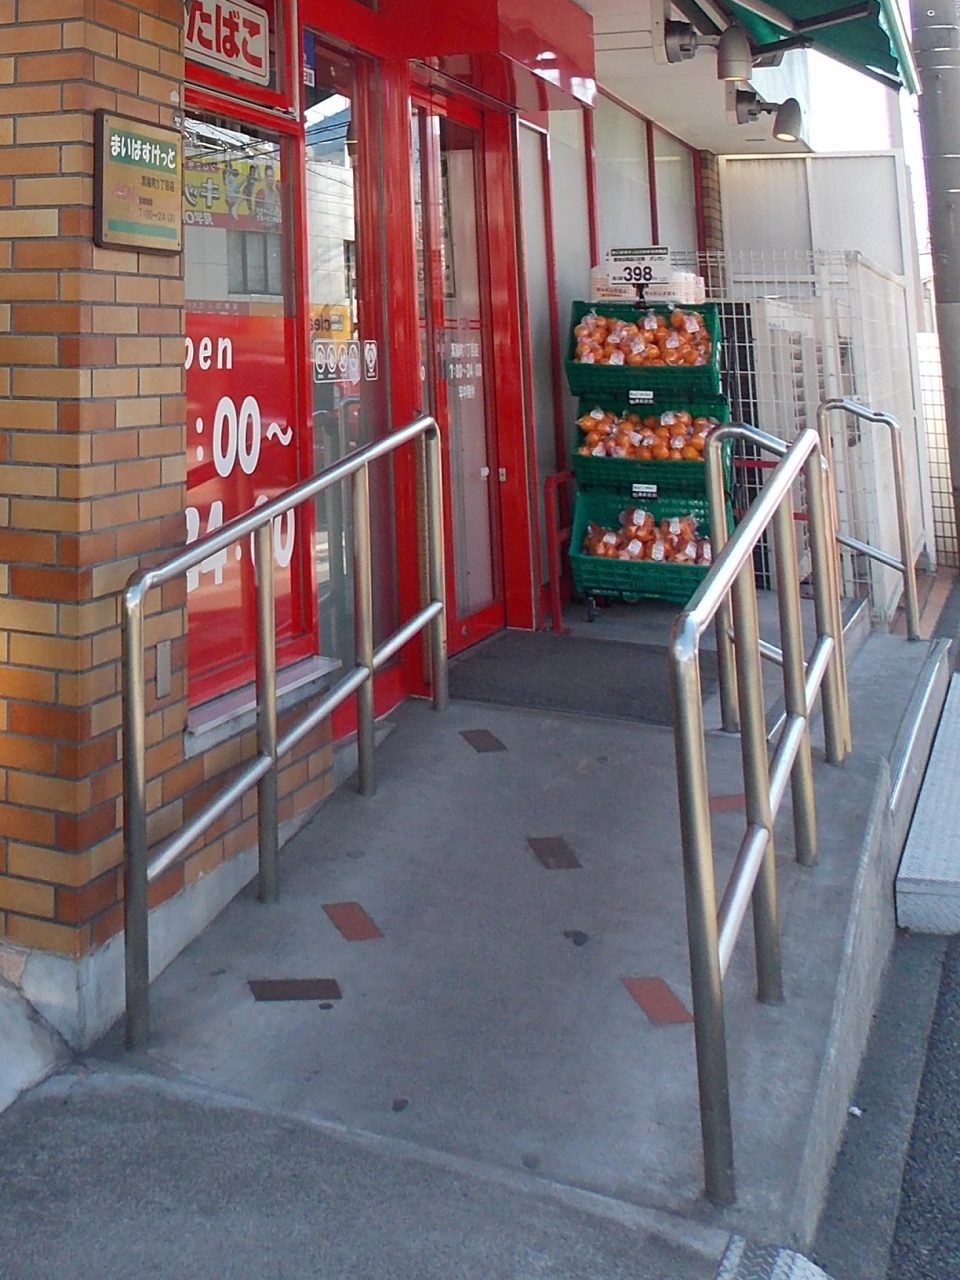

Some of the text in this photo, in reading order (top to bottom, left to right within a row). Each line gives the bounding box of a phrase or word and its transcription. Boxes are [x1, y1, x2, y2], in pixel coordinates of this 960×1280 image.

[110, 134, 176, 169] まいばすけっと
[623, 266, 653, 282] 398
